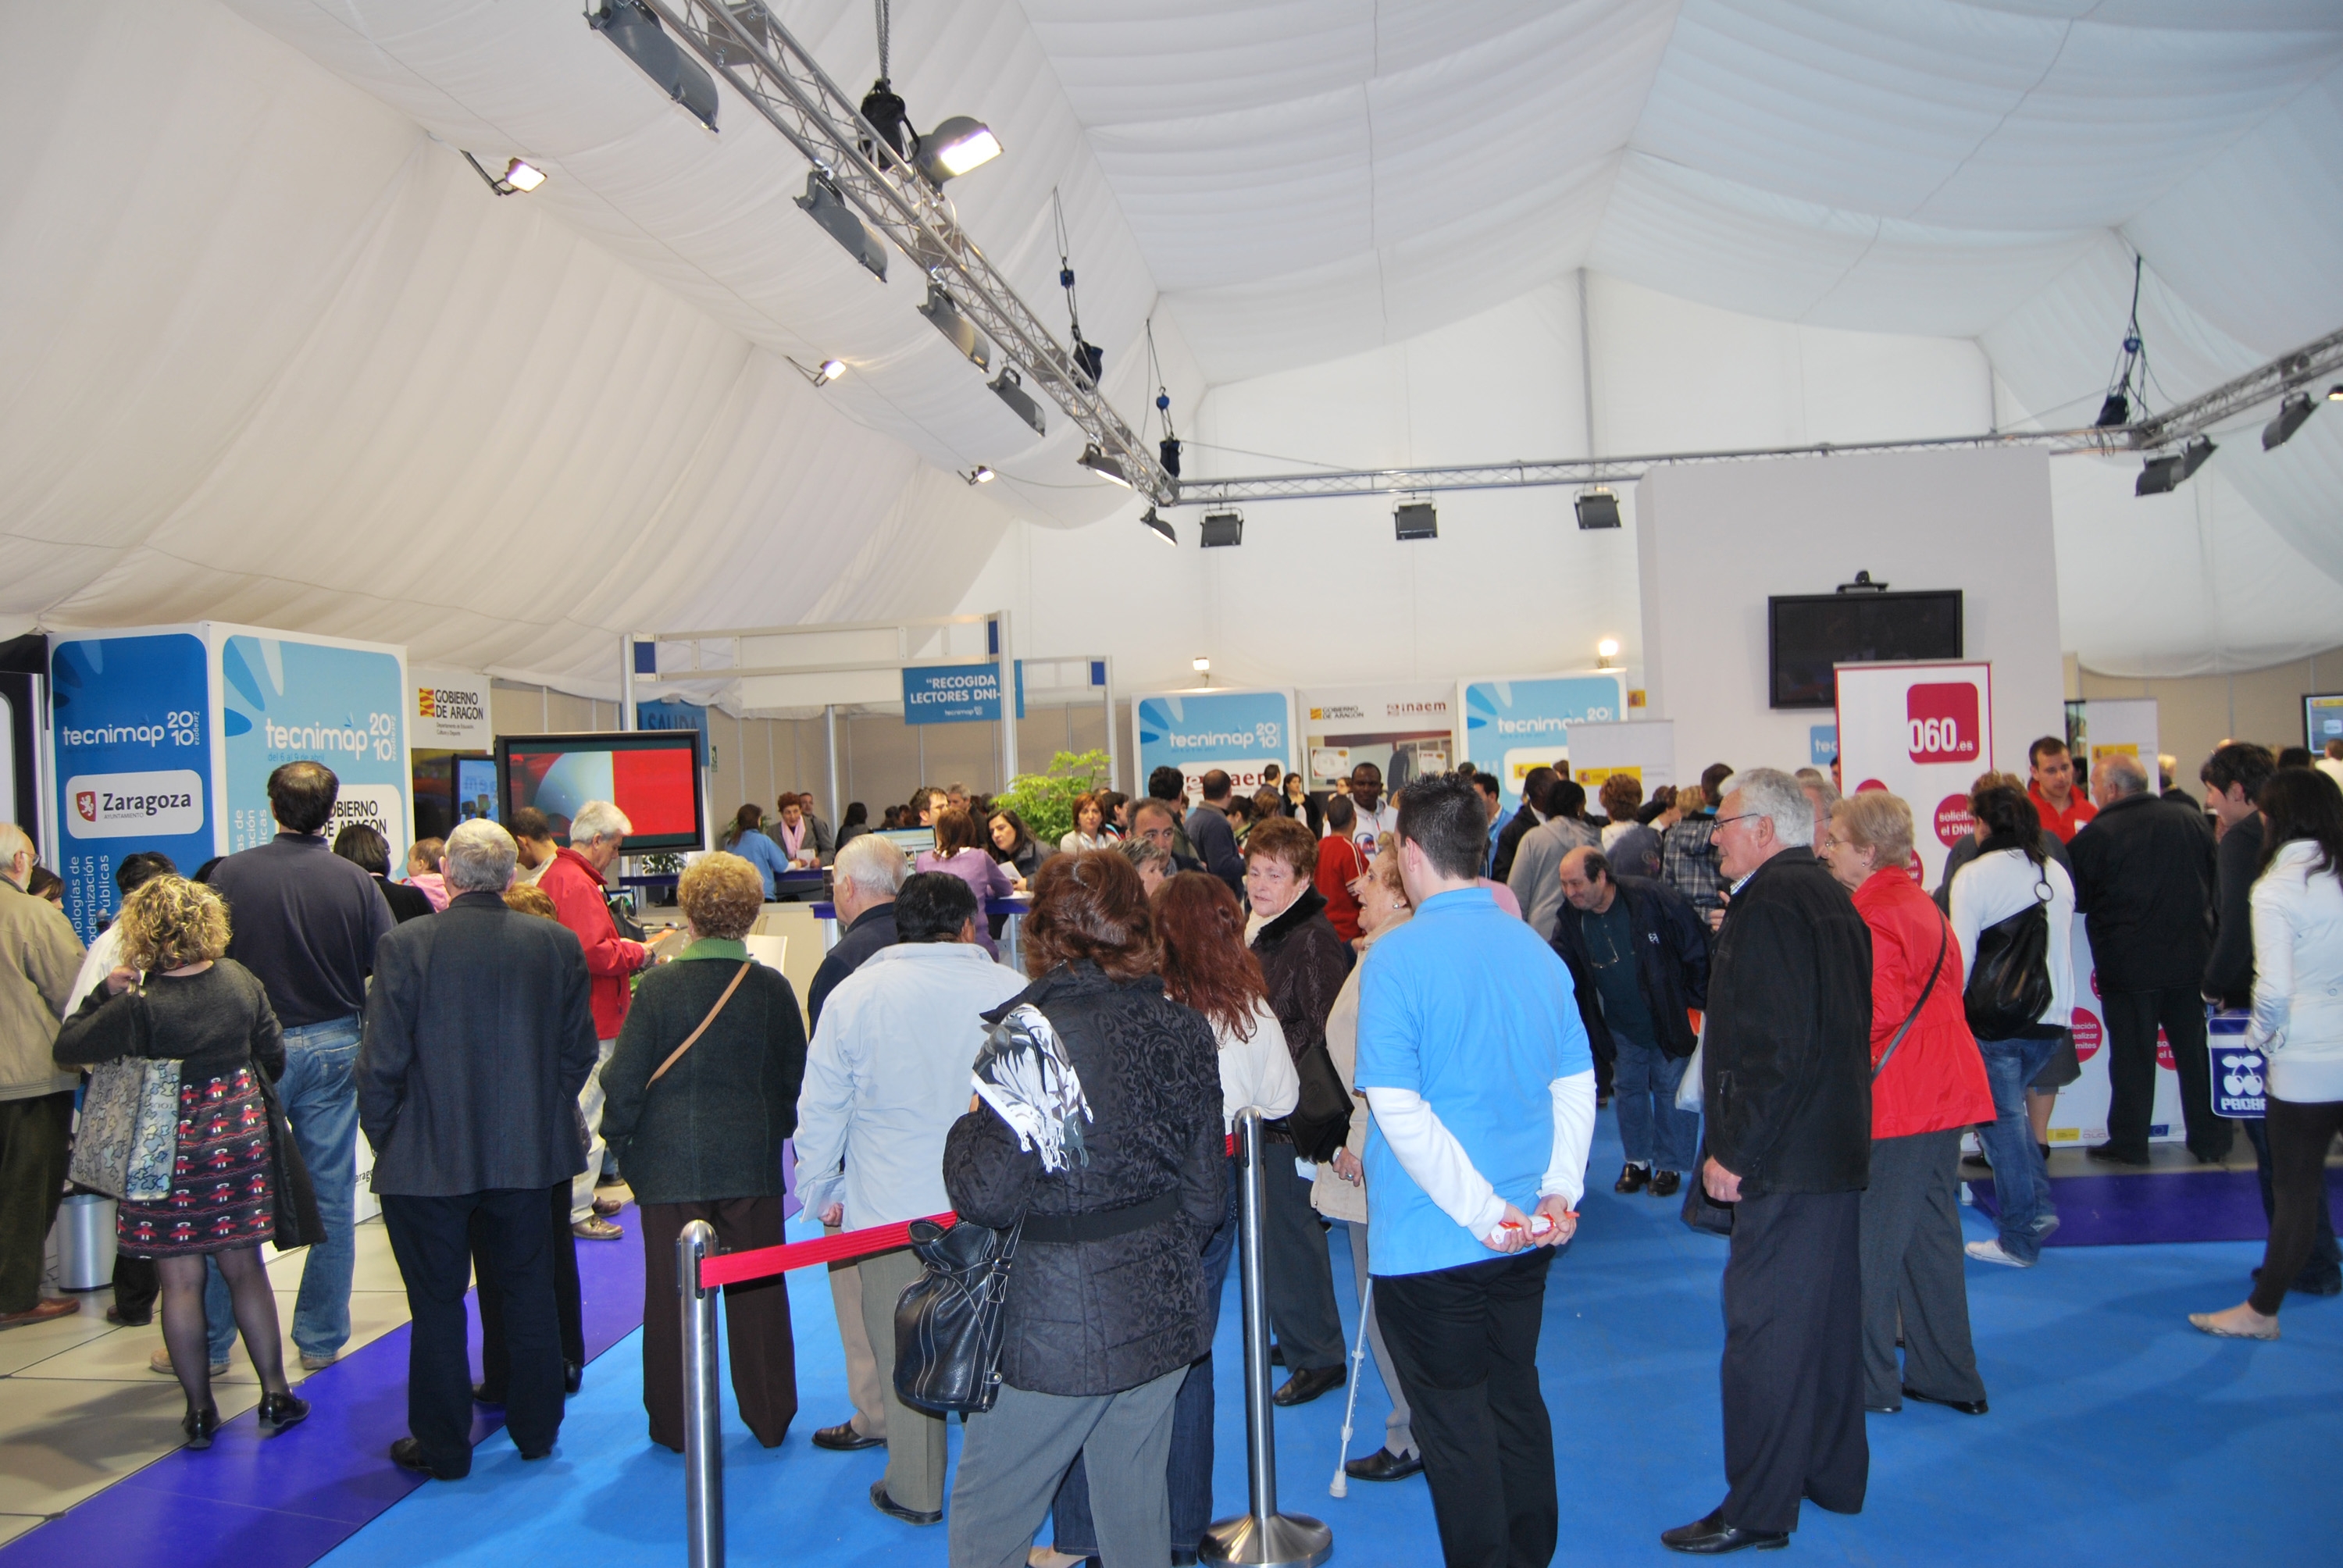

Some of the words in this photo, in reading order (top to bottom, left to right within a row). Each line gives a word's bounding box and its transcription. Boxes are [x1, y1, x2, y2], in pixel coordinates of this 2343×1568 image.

[435, 690, 479, 705] GOBIERNO
[911, 690, 969, 704] LECTORES
[974, 688, 1001, 700] DNI-
[436, 704, 448, 718] DE
[450, 706, 483, 720] ARAGON
[1402, 702, 1446, 712] inaem
[167, 711, 194, 729] 20
[369, 712, 391, 736] 20
[1256, 722, 1276, 736] 20
[62, 724, 165, 747] tecnimap
[171, 729, 194, 747] 10
[266, 718, 368, 761] tecnimap
[1169, 731, 1254, 749] tecnimap
[373, 738, 392, 761] 10
[1814, 738, 1837, 753] tec
[102, 793, 191, 816] Zaragoza
[234, 809, 244, 829] de
[258, 809, 268, 846] licas
[1941, 825, 1950, 836] el
[70, 856, 80, 875] de
